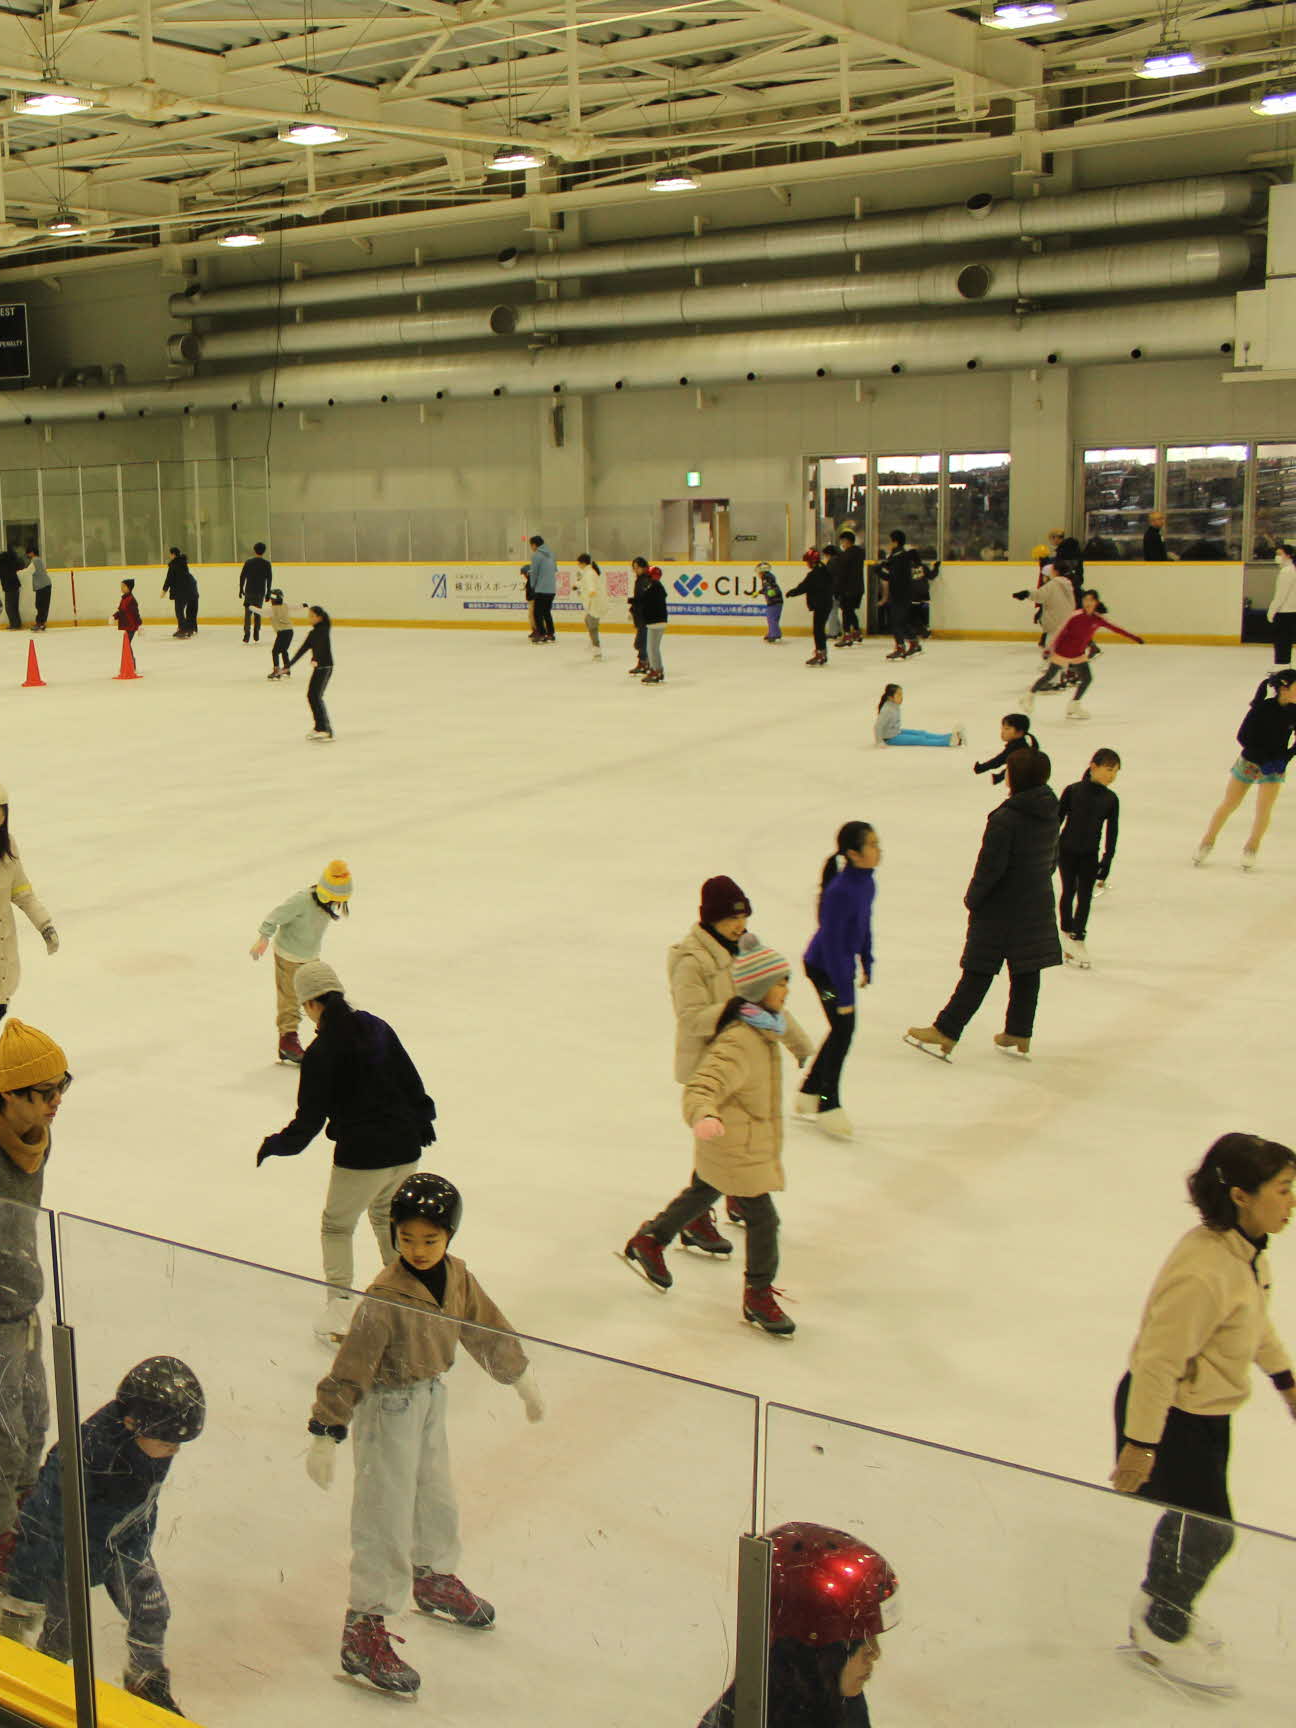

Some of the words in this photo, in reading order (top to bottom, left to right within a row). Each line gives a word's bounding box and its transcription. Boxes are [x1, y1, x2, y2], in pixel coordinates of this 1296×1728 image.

[0, 340, 23, 348] PENALTY
[455, 582, 527, 592] 横浜市スポーツ
[715, 576, 758, 596] CIJ
